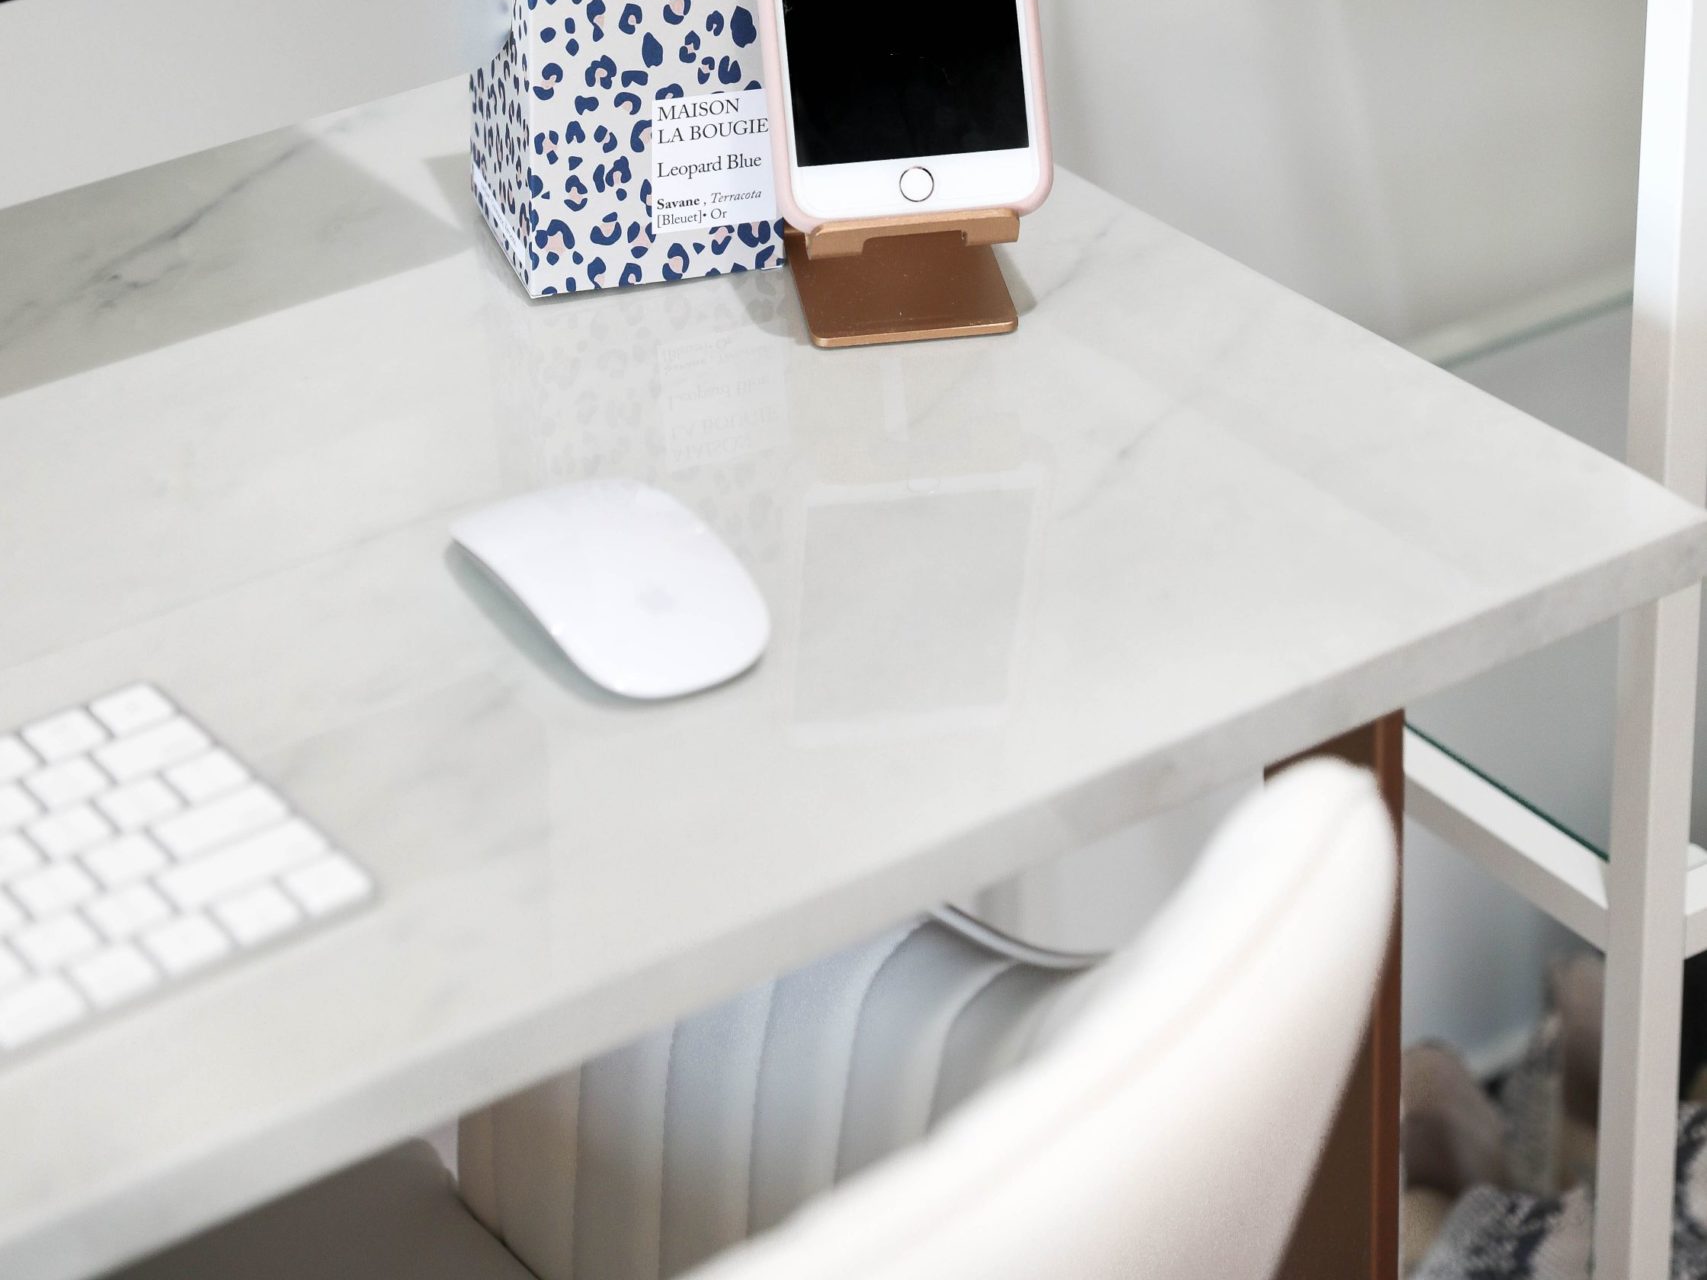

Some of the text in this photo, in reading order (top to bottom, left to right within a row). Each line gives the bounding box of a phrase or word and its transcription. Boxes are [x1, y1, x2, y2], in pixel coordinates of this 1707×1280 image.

[658, 98, 740, 121] MAISON
[658, 118, 769, 144] LA BOUGIE
[657, 154, 762, 180] Leopard Blue
[657, 197, 700, 210] Savane
[711, 189, 762, 204] Terracota
[710, 208, 728, 220] Or
